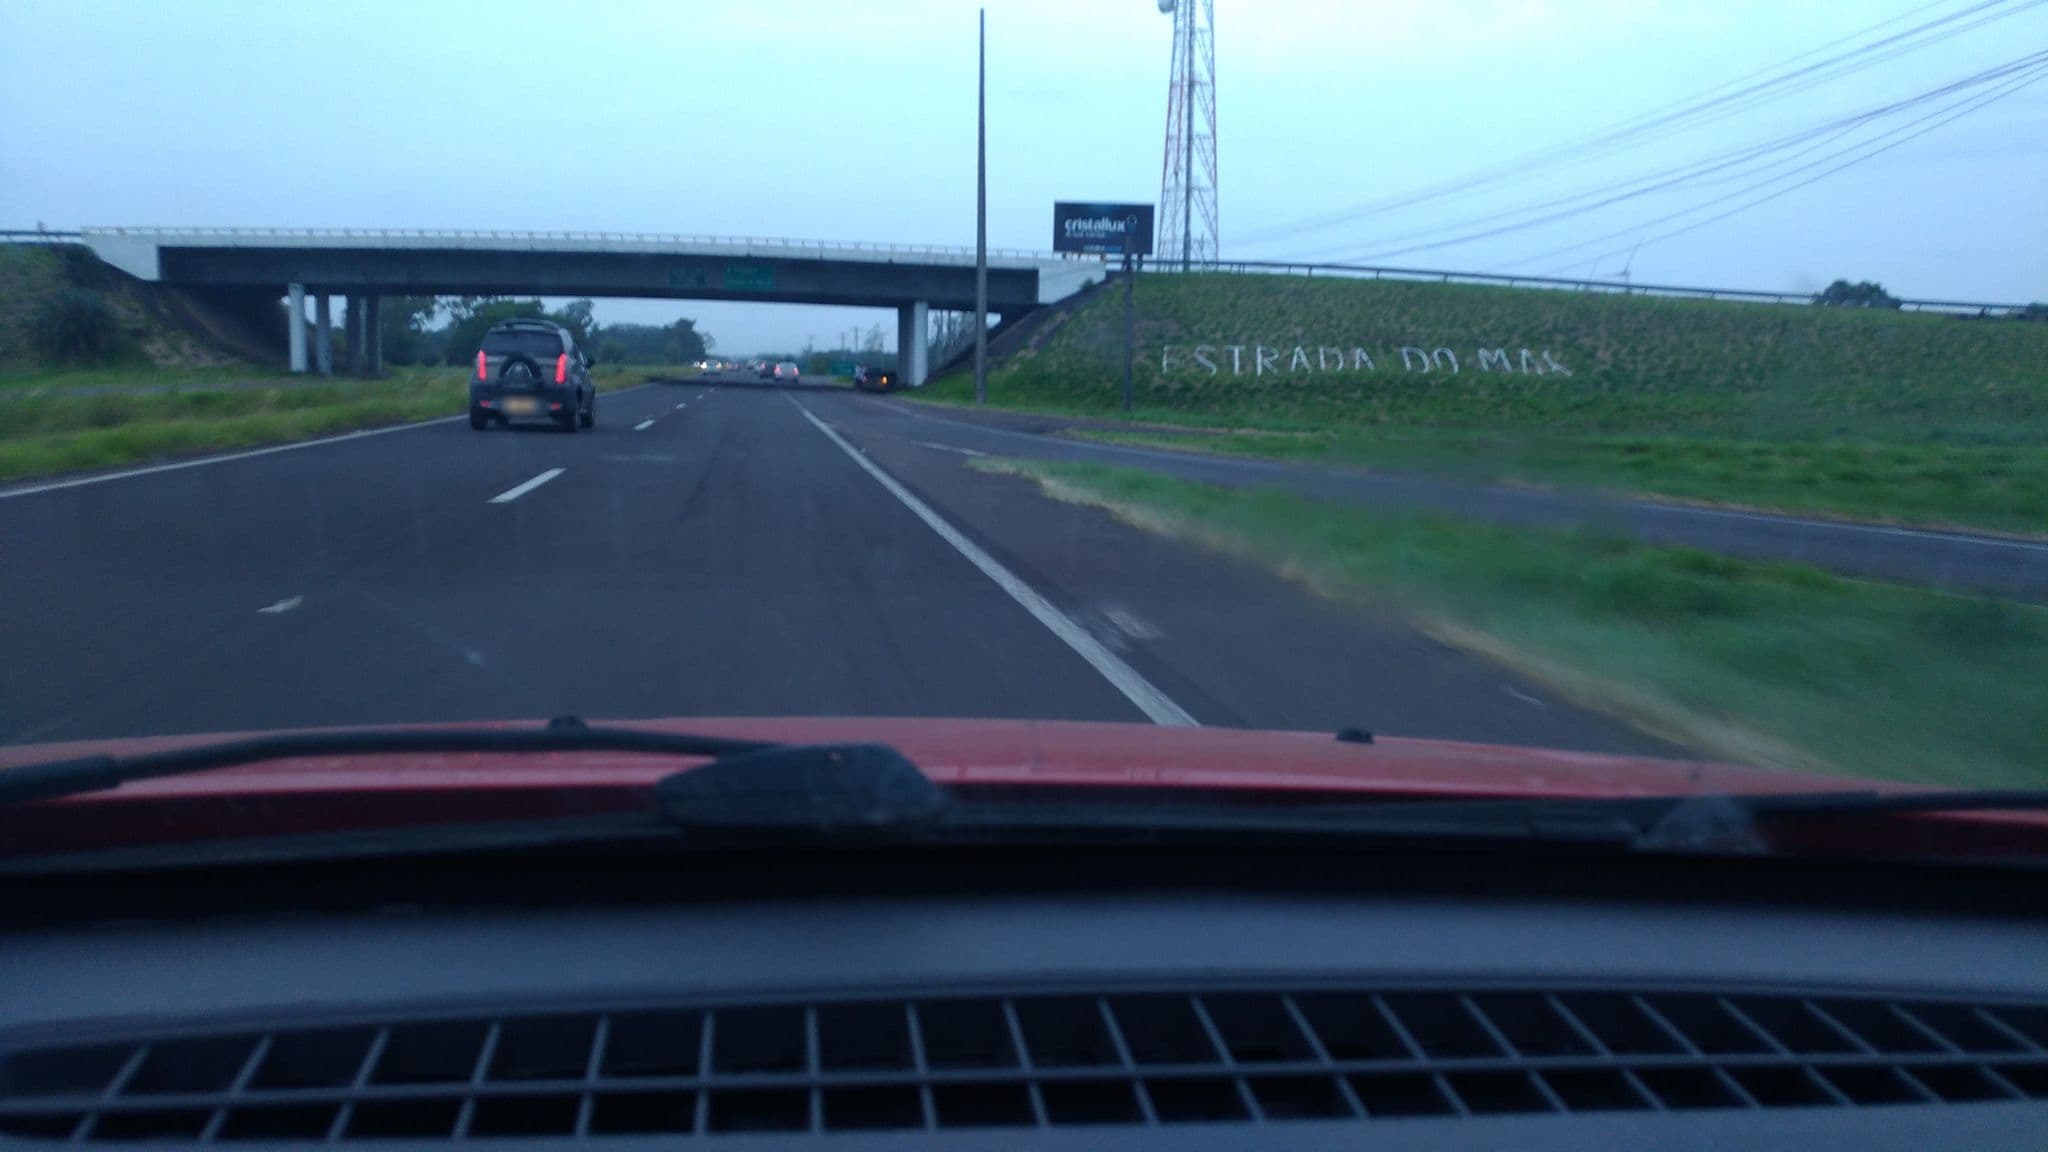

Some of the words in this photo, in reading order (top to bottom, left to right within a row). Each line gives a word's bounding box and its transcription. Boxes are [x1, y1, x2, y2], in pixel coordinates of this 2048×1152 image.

[1064, 216, 1126, 233] cristallux
[1162, 344, 1375, 376] ESTRADA
[1400, 346, 1459, 375] DO
